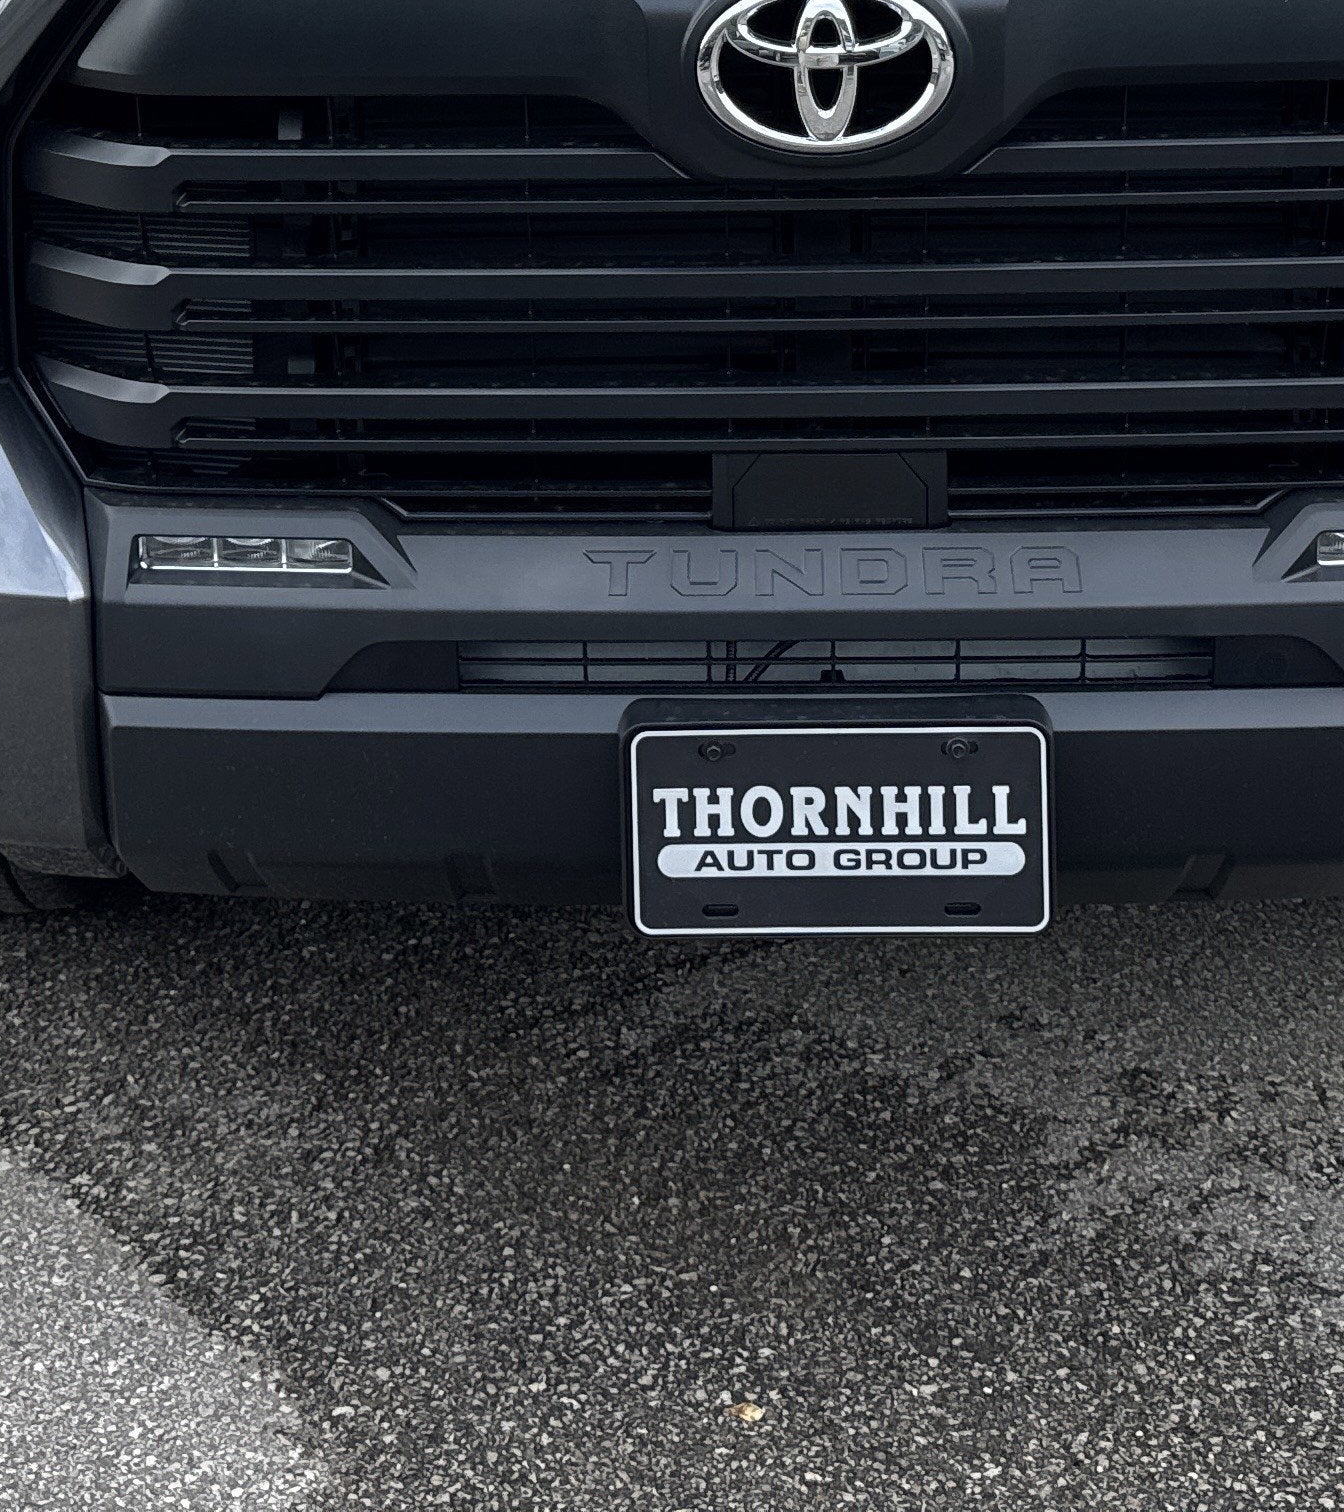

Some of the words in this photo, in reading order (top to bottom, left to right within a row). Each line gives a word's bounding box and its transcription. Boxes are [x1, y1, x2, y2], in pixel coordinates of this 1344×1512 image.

[582, 545, 1084, 597] TUNDRA
[652, 785, 1027, 838] THORNHILL
[694, 848, 817, 872] AUTO
[833, 847, 988, 871] GROUP
